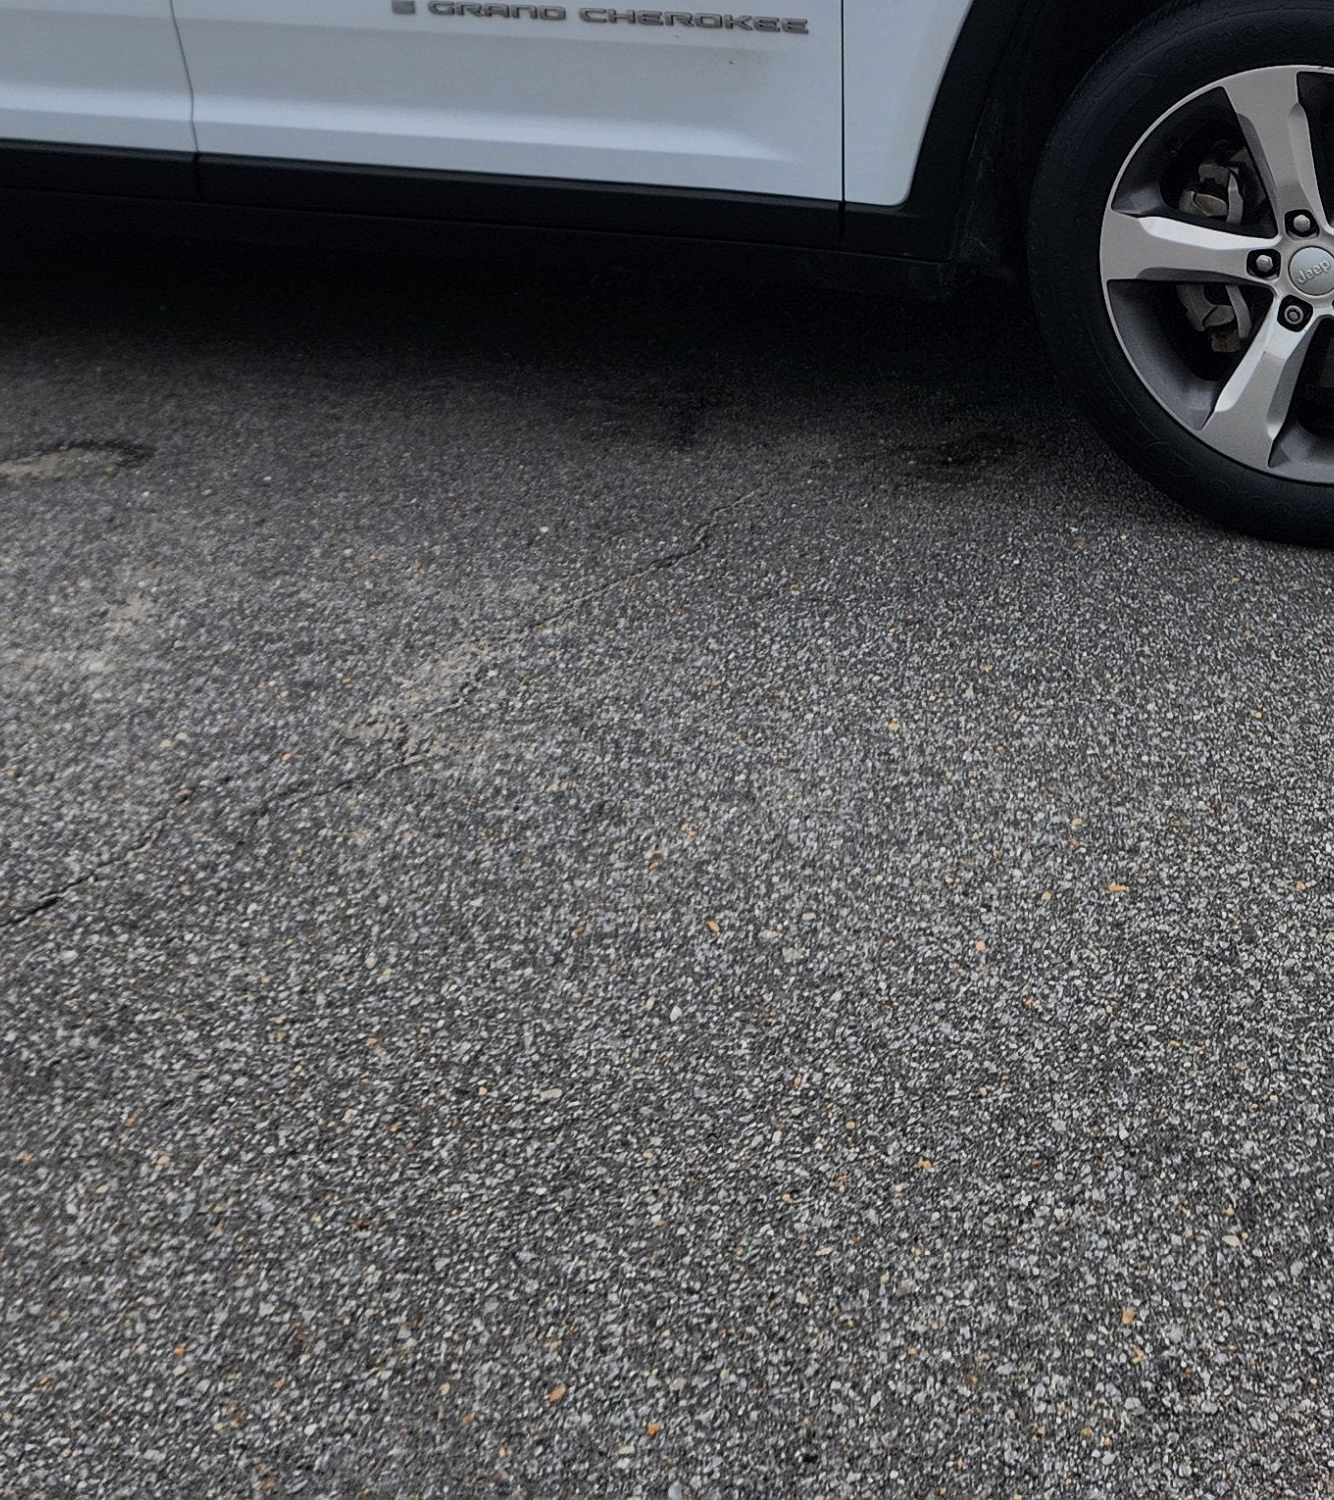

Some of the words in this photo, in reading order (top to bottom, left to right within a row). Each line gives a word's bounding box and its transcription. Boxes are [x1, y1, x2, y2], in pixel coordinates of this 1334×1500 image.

[427, 0, 566, 21] GRAND
[578, 7, 809, 34] CHEROKEE
[1297, 260, 1330, 283] Jeep
